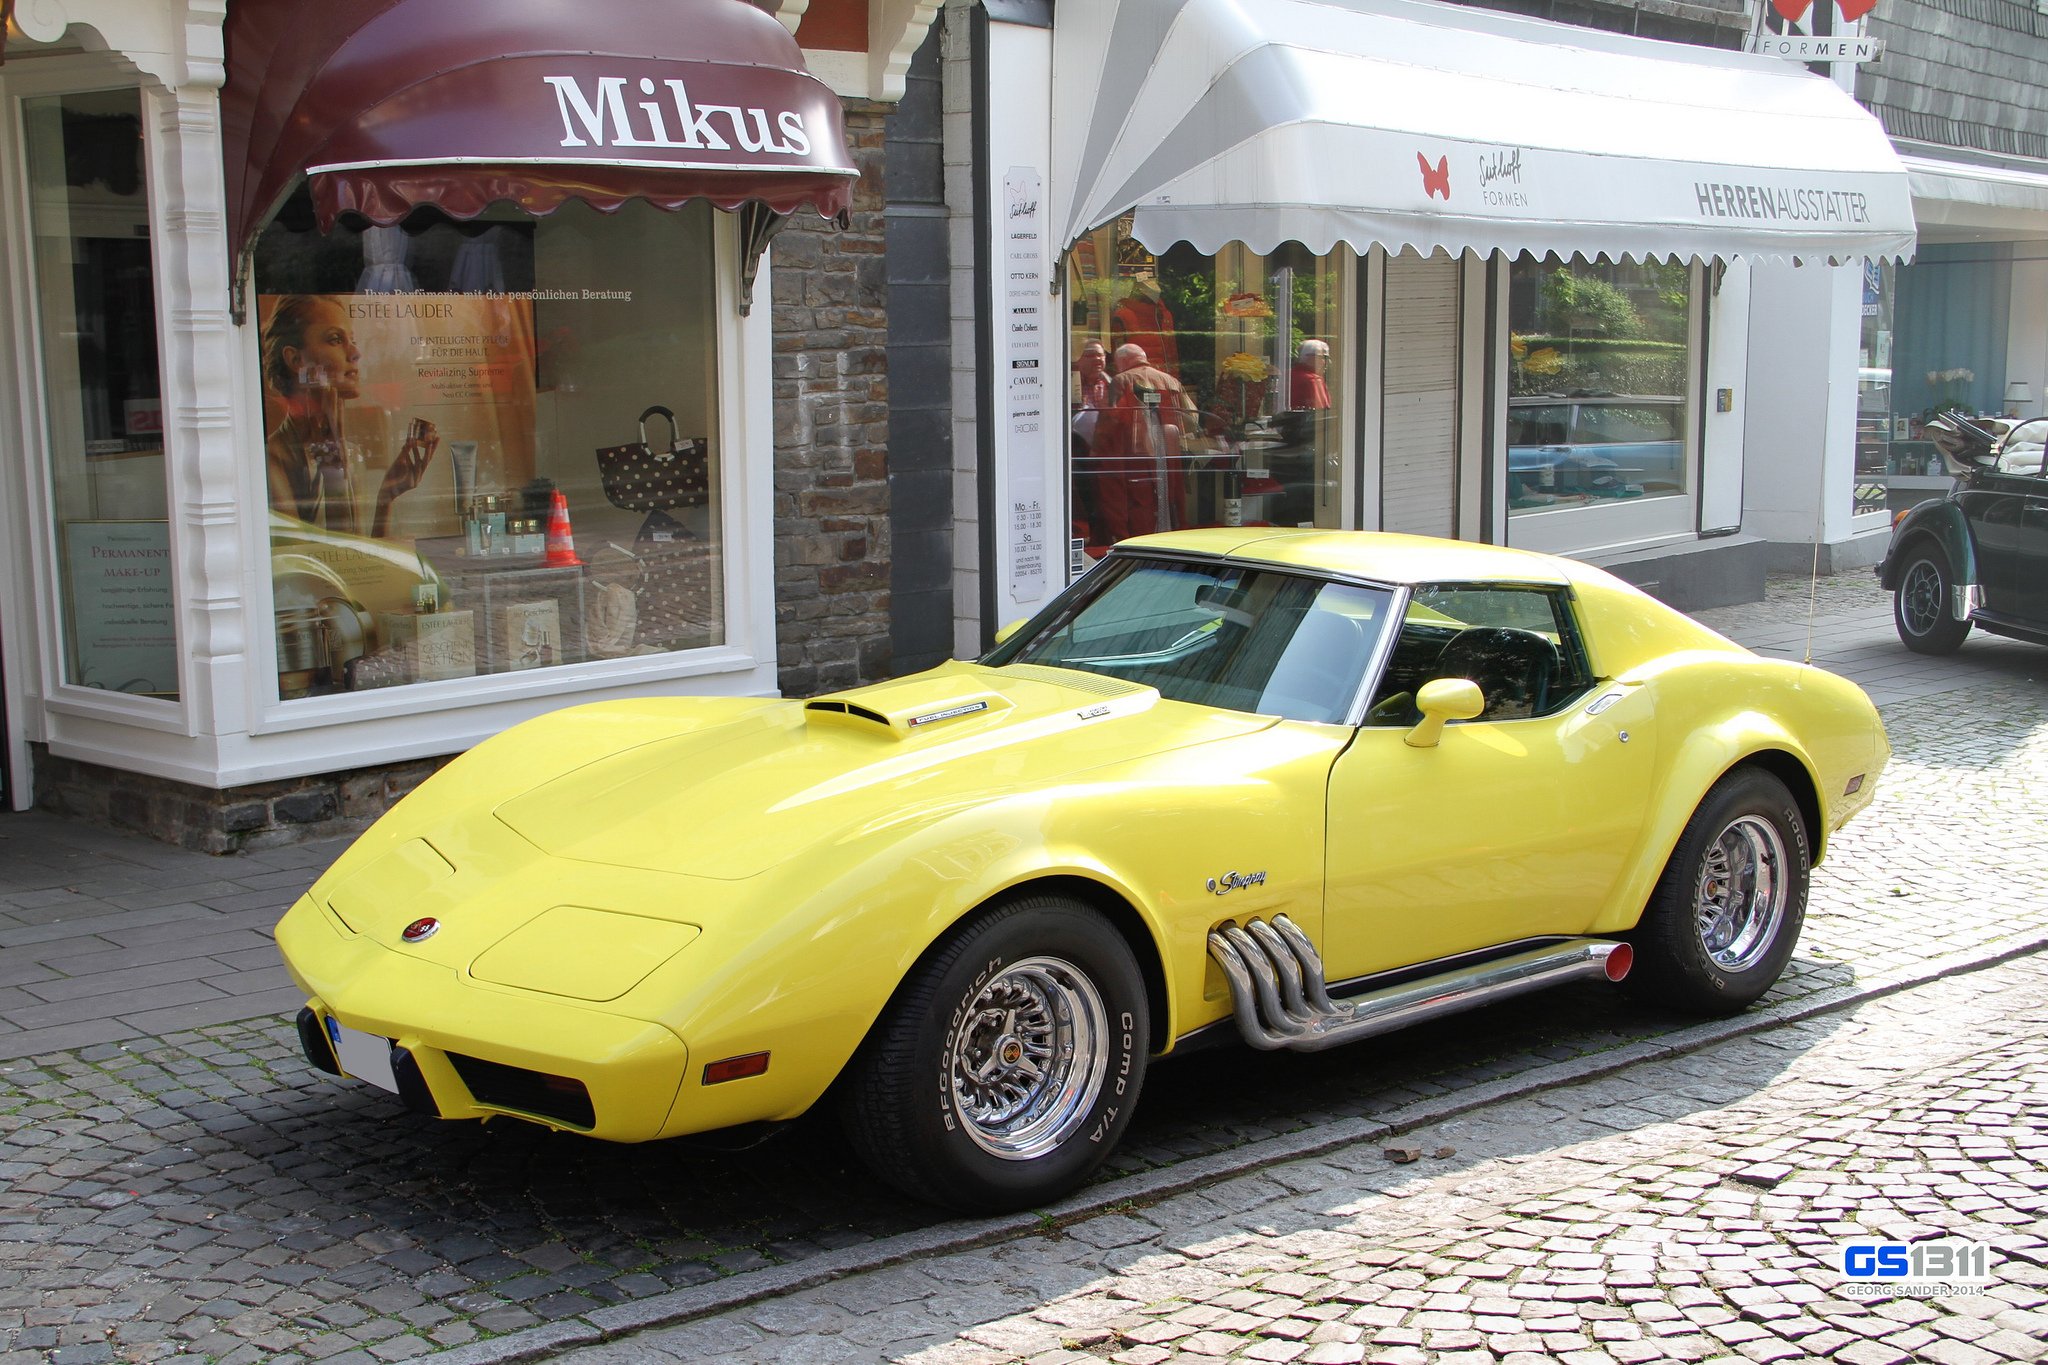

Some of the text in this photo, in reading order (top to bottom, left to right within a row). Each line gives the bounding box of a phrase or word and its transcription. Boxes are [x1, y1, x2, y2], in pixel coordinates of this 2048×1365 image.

[1763, 40, 1868, 57] FORMEN
[543, 76, 811, 156] Mikus
[1482, 191, 1529, 208] FORMEN
[1694, 182, 1871, 223] HERRENAUSSTATTER
[1010, 252, 1022, 260] CARL
[1010, 272, 1039, 280] OTTO KERN
[463, 288, 483, 300] mit
[486, 289, 506, 300] der
[508, 288, 578, 303] persönlichen
[582, 288, 632, 302] Beratung
[396, 302, 454, 318] LAUDER
[426, 336, 480, 345] INTELLIGENTE
[432, 347, 488, 357] FÜR DIE HAUT
[418, 367, 466, 379] Revitalizing
[1013, 376, 1038, 386] CAVORI
[1015, 423, 1039, 433] HOM
[1032, 501, 1041, 509] Fr.
[91, 546, 170, 559] PERMANENT
[104, 567, 161, 577] MAKE-UP
[1783, 807, 1808, 880] Radial
[939, 956, 1002, 1132] BFGoodrich
[1089, 1012, 1133, 1143] Comp T/A
